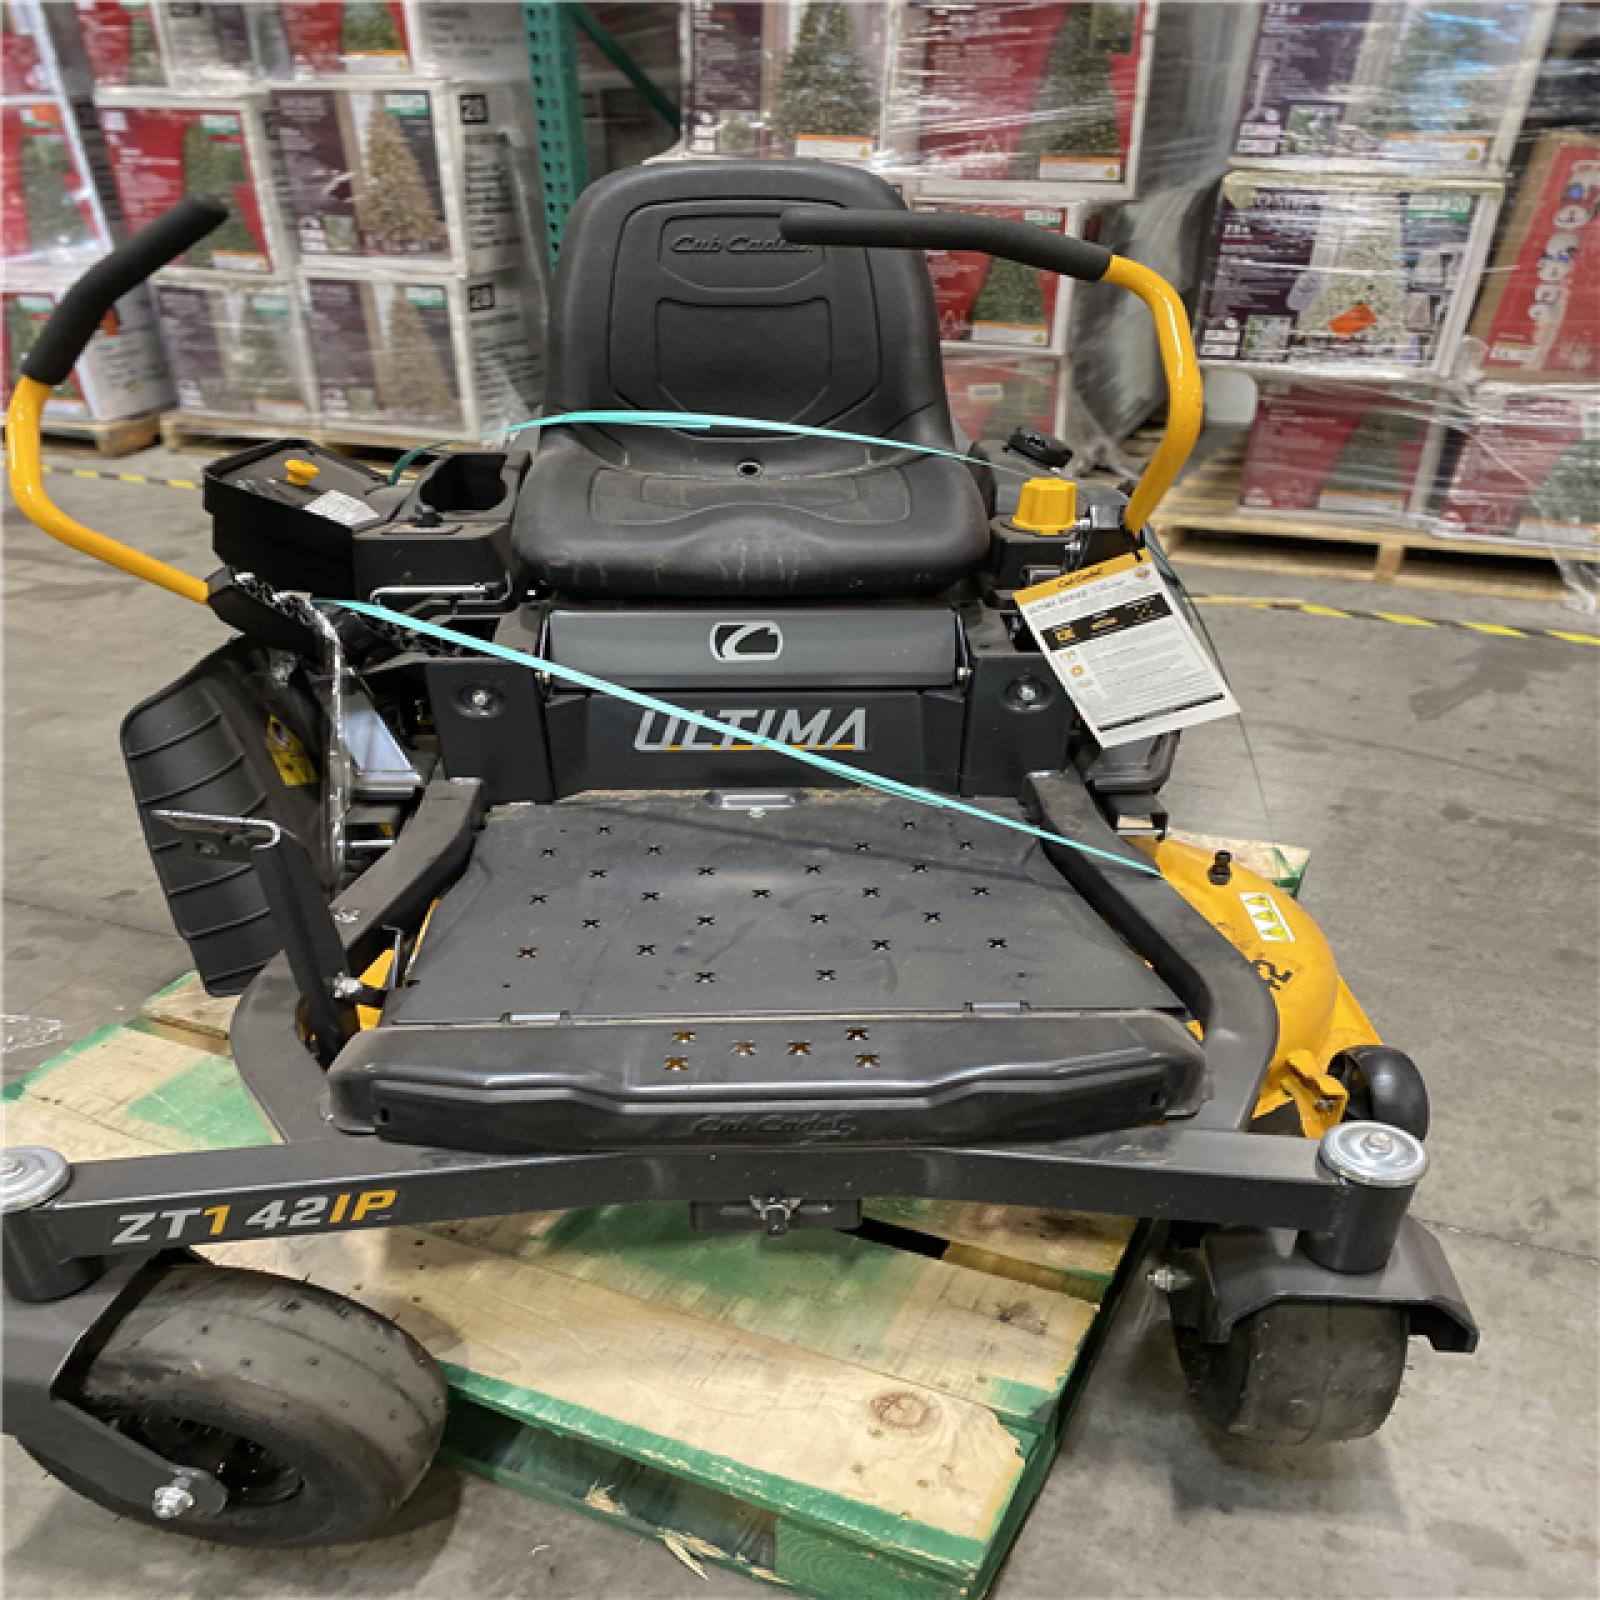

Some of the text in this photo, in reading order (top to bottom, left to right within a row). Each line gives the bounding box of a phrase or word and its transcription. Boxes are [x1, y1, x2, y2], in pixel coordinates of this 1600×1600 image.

[634, 709, 866, 751] ULTIMA
[111, 1189, 397, 1246] ZT1 42IP
